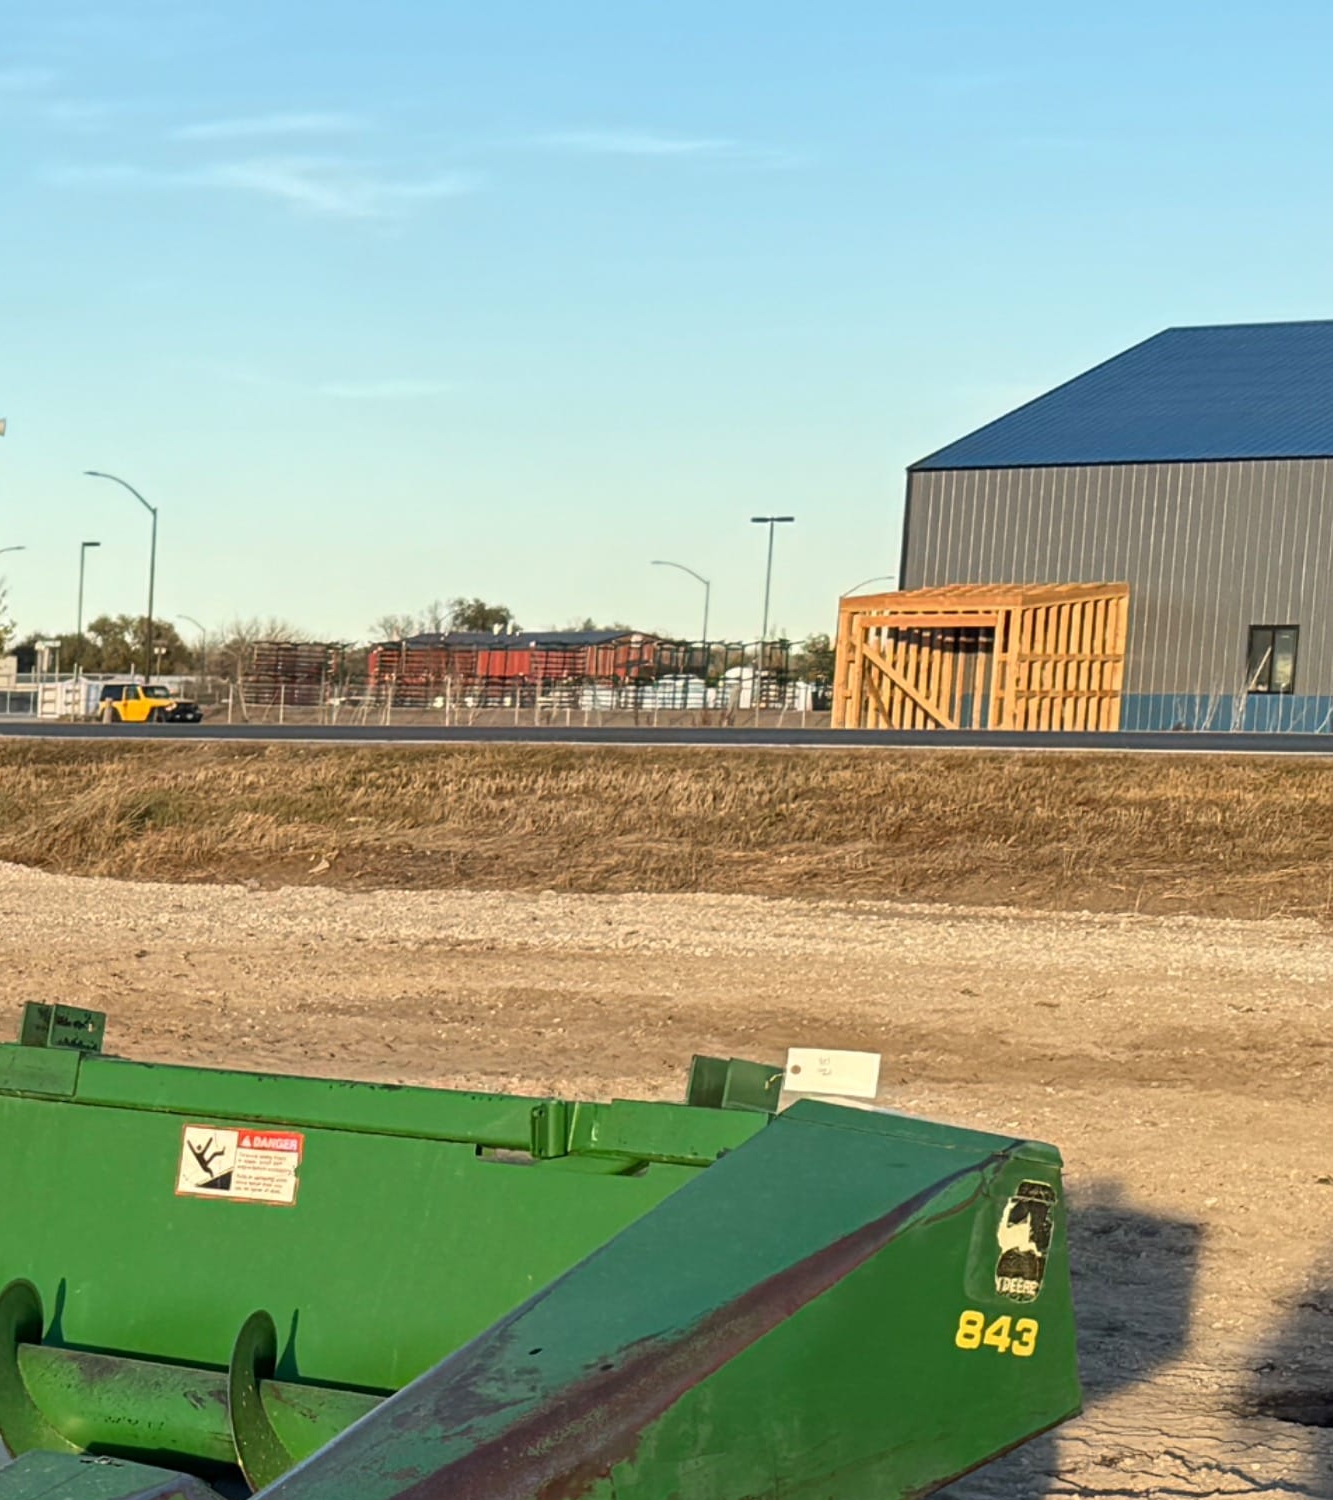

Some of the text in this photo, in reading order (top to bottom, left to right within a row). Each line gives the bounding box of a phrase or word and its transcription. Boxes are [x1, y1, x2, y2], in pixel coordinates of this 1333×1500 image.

[252, 1136, 298, 1151] DANGER
[1003, 1277, 1039, 1296] DEERE
[955, 1309, 1039, 1357] 843
